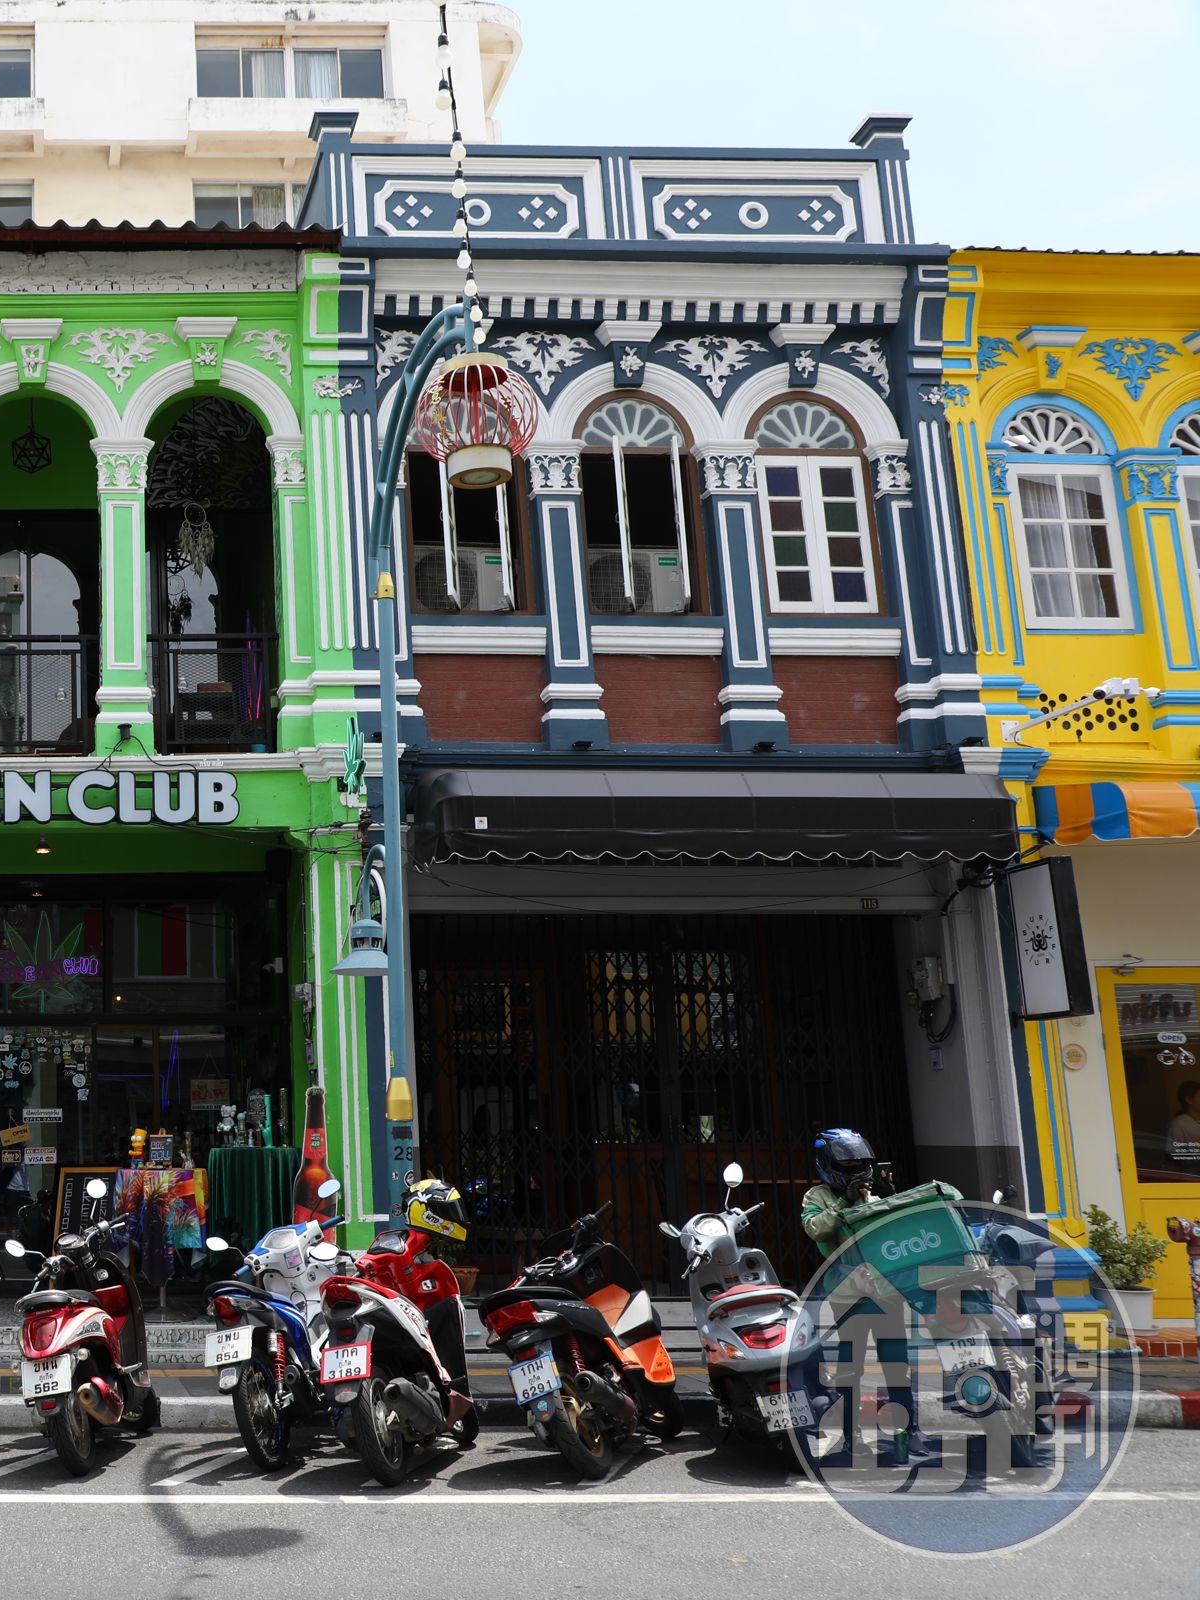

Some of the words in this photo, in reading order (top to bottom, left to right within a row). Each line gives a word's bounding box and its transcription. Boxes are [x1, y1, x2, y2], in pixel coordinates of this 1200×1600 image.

[67, 769, 240, 824] CLUB
[863, 898, 878, 909] 115
[1161, 1035, 1182, 1043] OPEN
[192, 1087, 228, 1101] RAW
[881, 1229, 942, 1261] Grab
[216, 1350, 239, 1363] 854
[328, 1366, 361, 1380] 3189
[34, 1381, 59, 1394] 562
[522, 1379, 553, 1399] 6291
[774, 1415, 808, 1429] 4239
